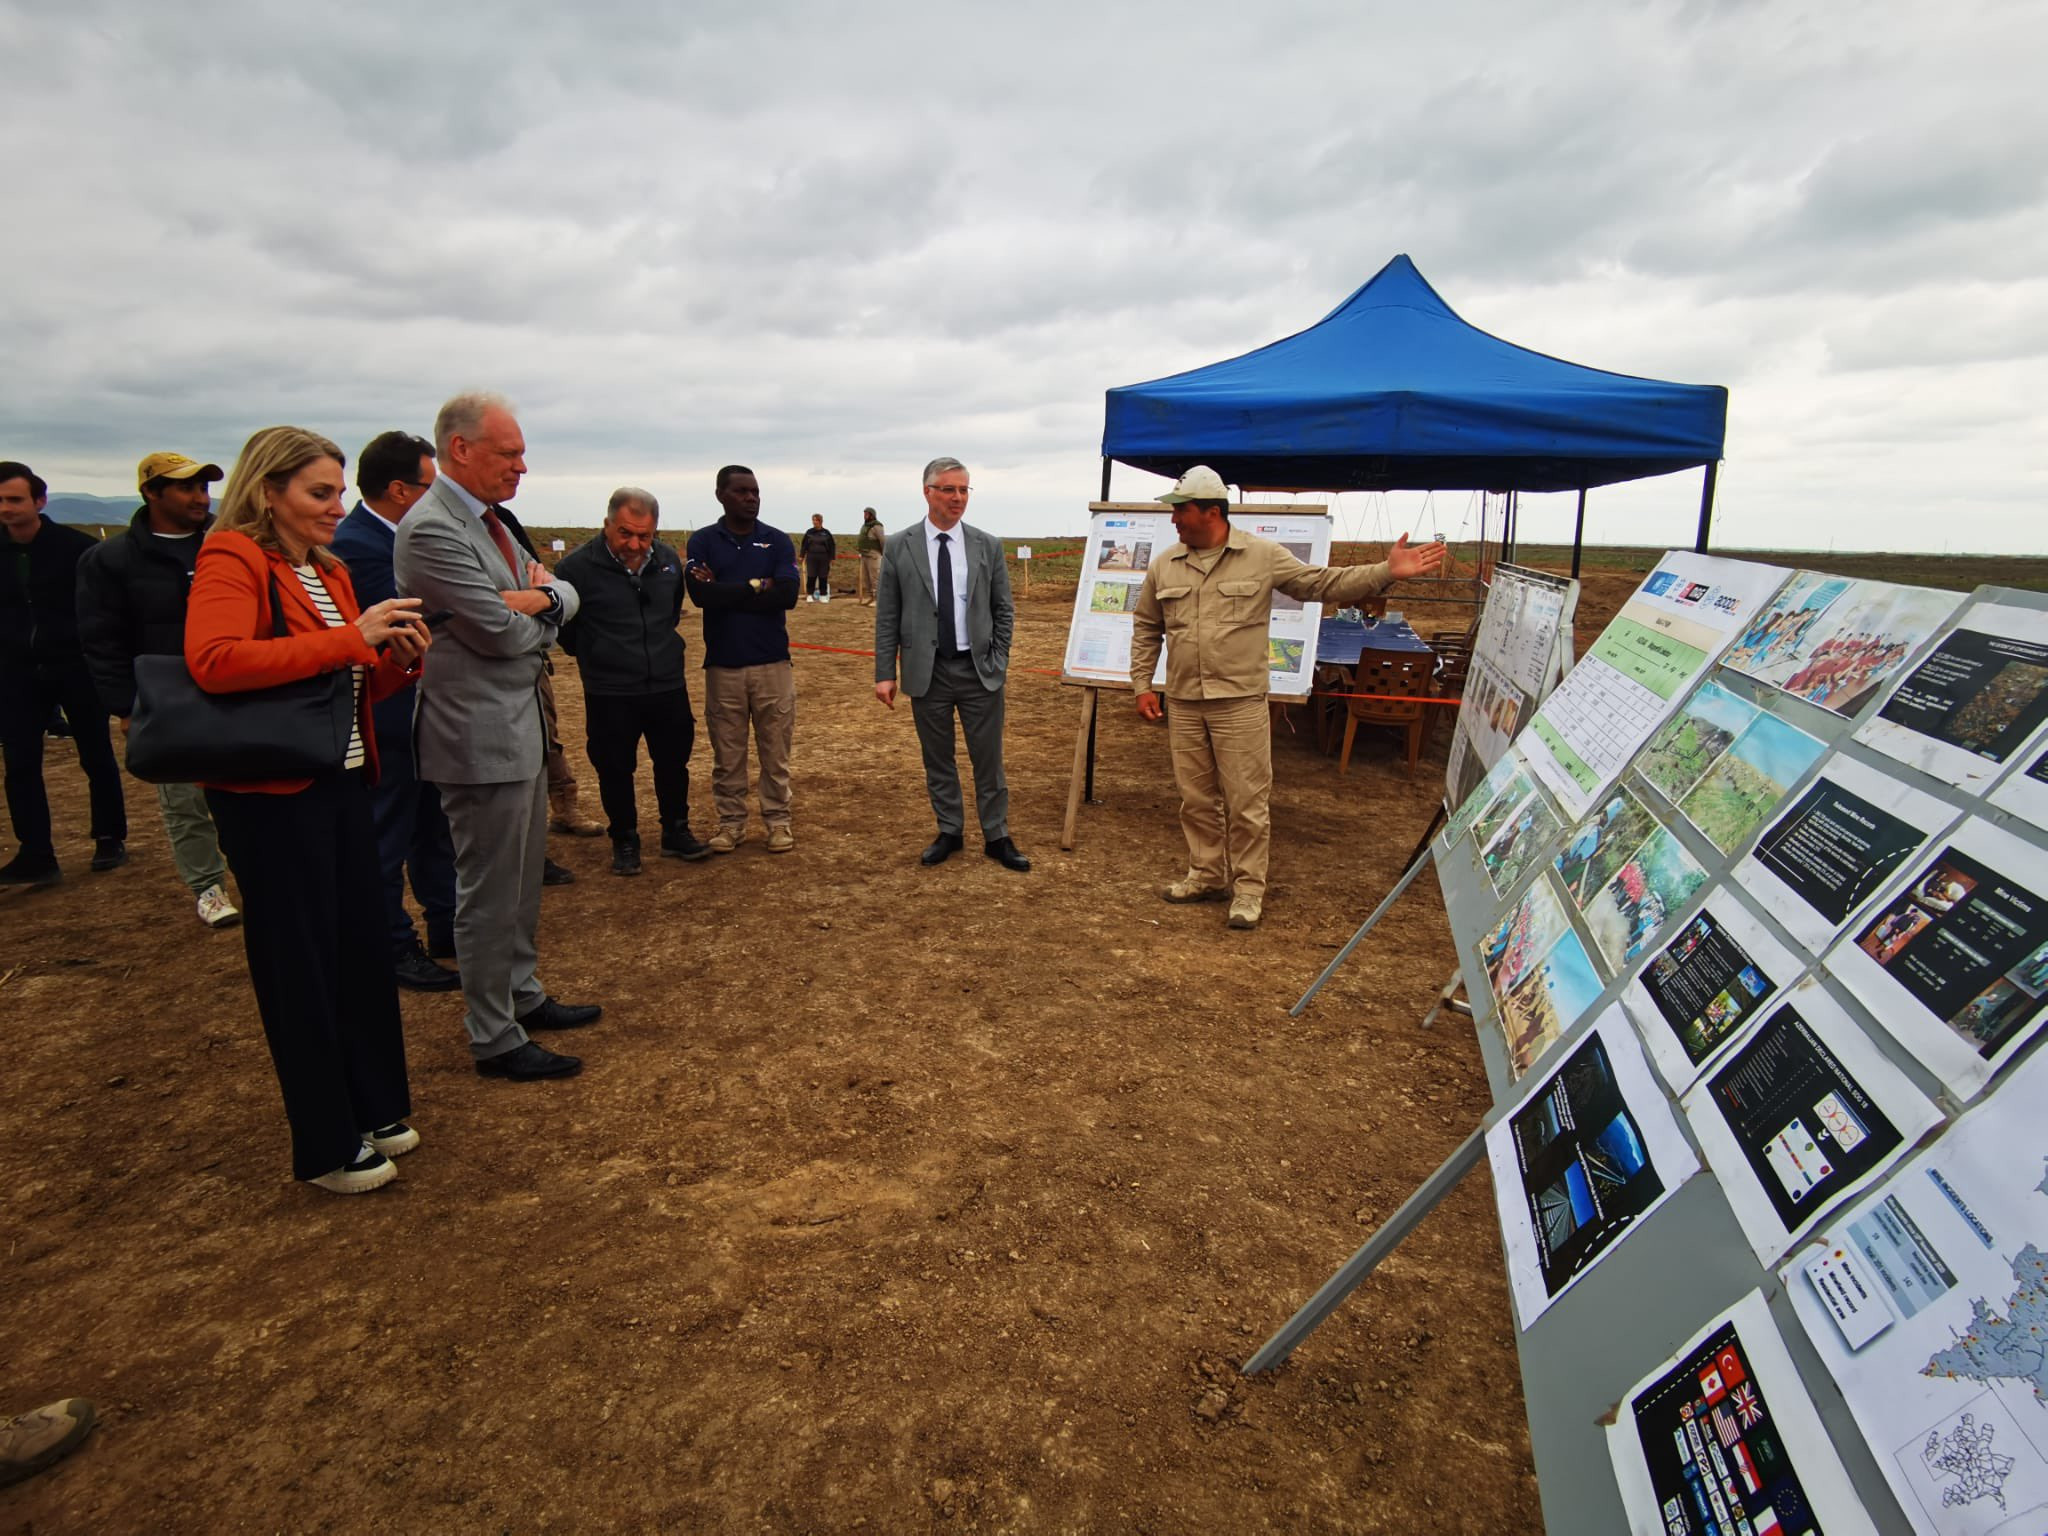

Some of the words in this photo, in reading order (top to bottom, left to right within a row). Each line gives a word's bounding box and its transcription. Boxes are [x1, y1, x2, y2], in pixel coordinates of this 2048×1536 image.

[1814, 1044, 1836, 1069] DECLARED
[1832, 1067, 1854, 1091] NATIONAL
[1940, 1180, 1968, 1211] INCIDENTS
[1963, 1208, 1994, 1243] LOCATIONS
[1849, 1274, 1868, 1299] incidents
